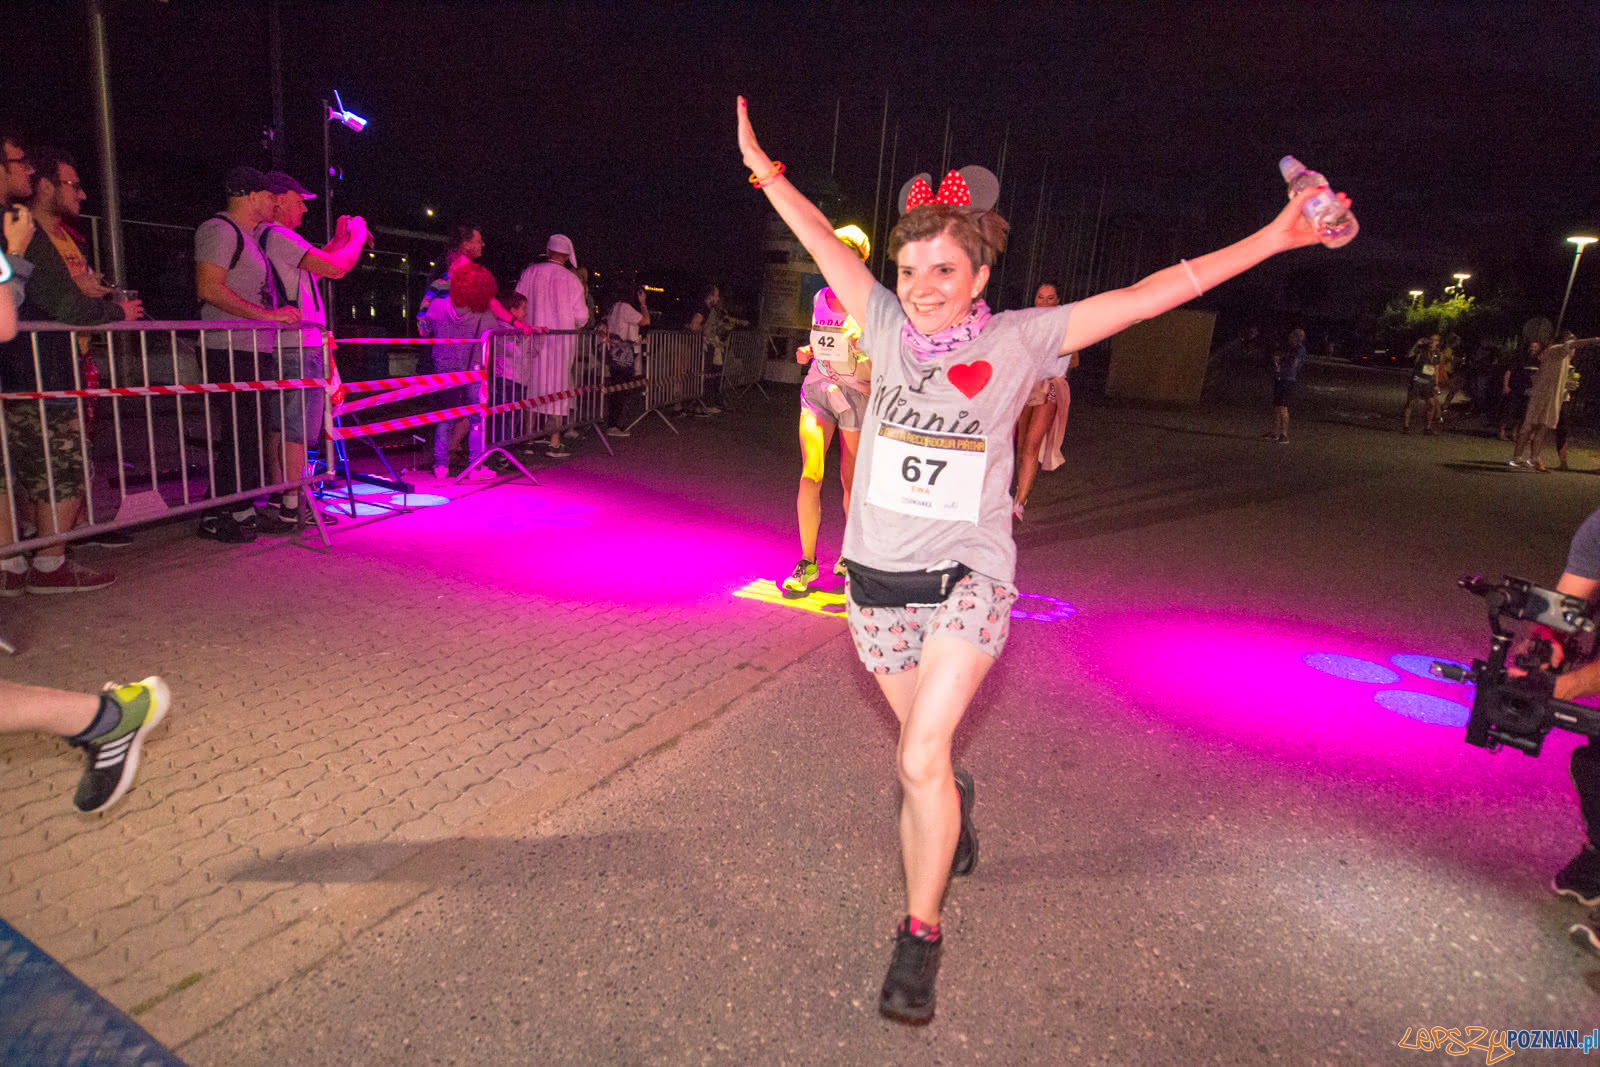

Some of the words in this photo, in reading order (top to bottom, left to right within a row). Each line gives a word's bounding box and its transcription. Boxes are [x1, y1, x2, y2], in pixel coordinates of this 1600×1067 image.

[817, 335, 835, 348] 42
[871, 374, 984, 435] Minnie
[901, 454, 948, 486] 67
